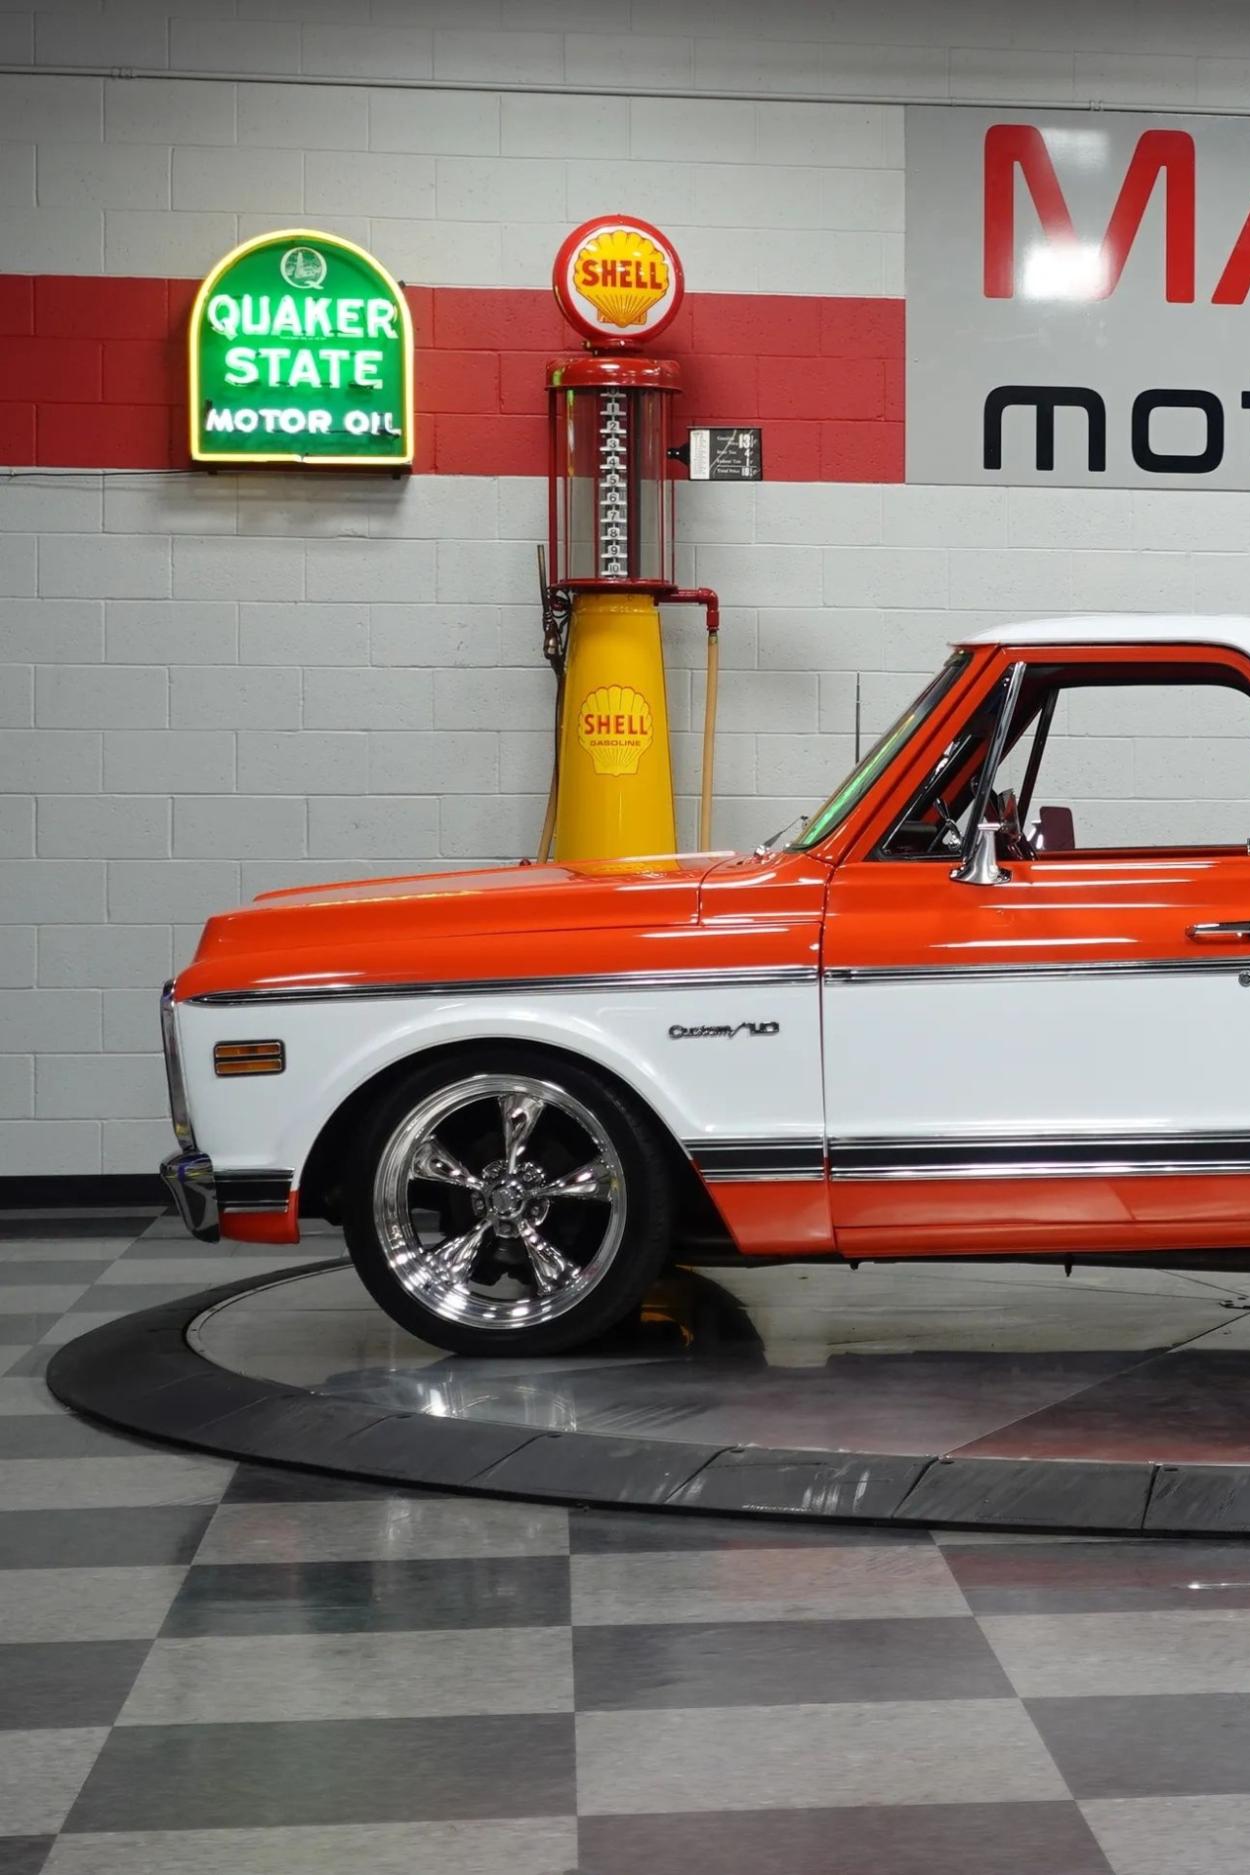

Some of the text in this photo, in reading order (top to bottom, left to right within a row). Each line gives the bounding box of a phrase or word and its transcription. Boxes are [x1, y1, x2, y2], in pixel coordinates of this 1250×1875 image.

[581, 259, 663, 290] SHELL
[207, 294, 399, 341] QUAKER
[224, 347, 384, 389] STATE
[206, 408, 401, 436] MOTOR OIL
[584, 713, 648, 735] SHELL
[590, 739, 641, 747] GASOLINE
